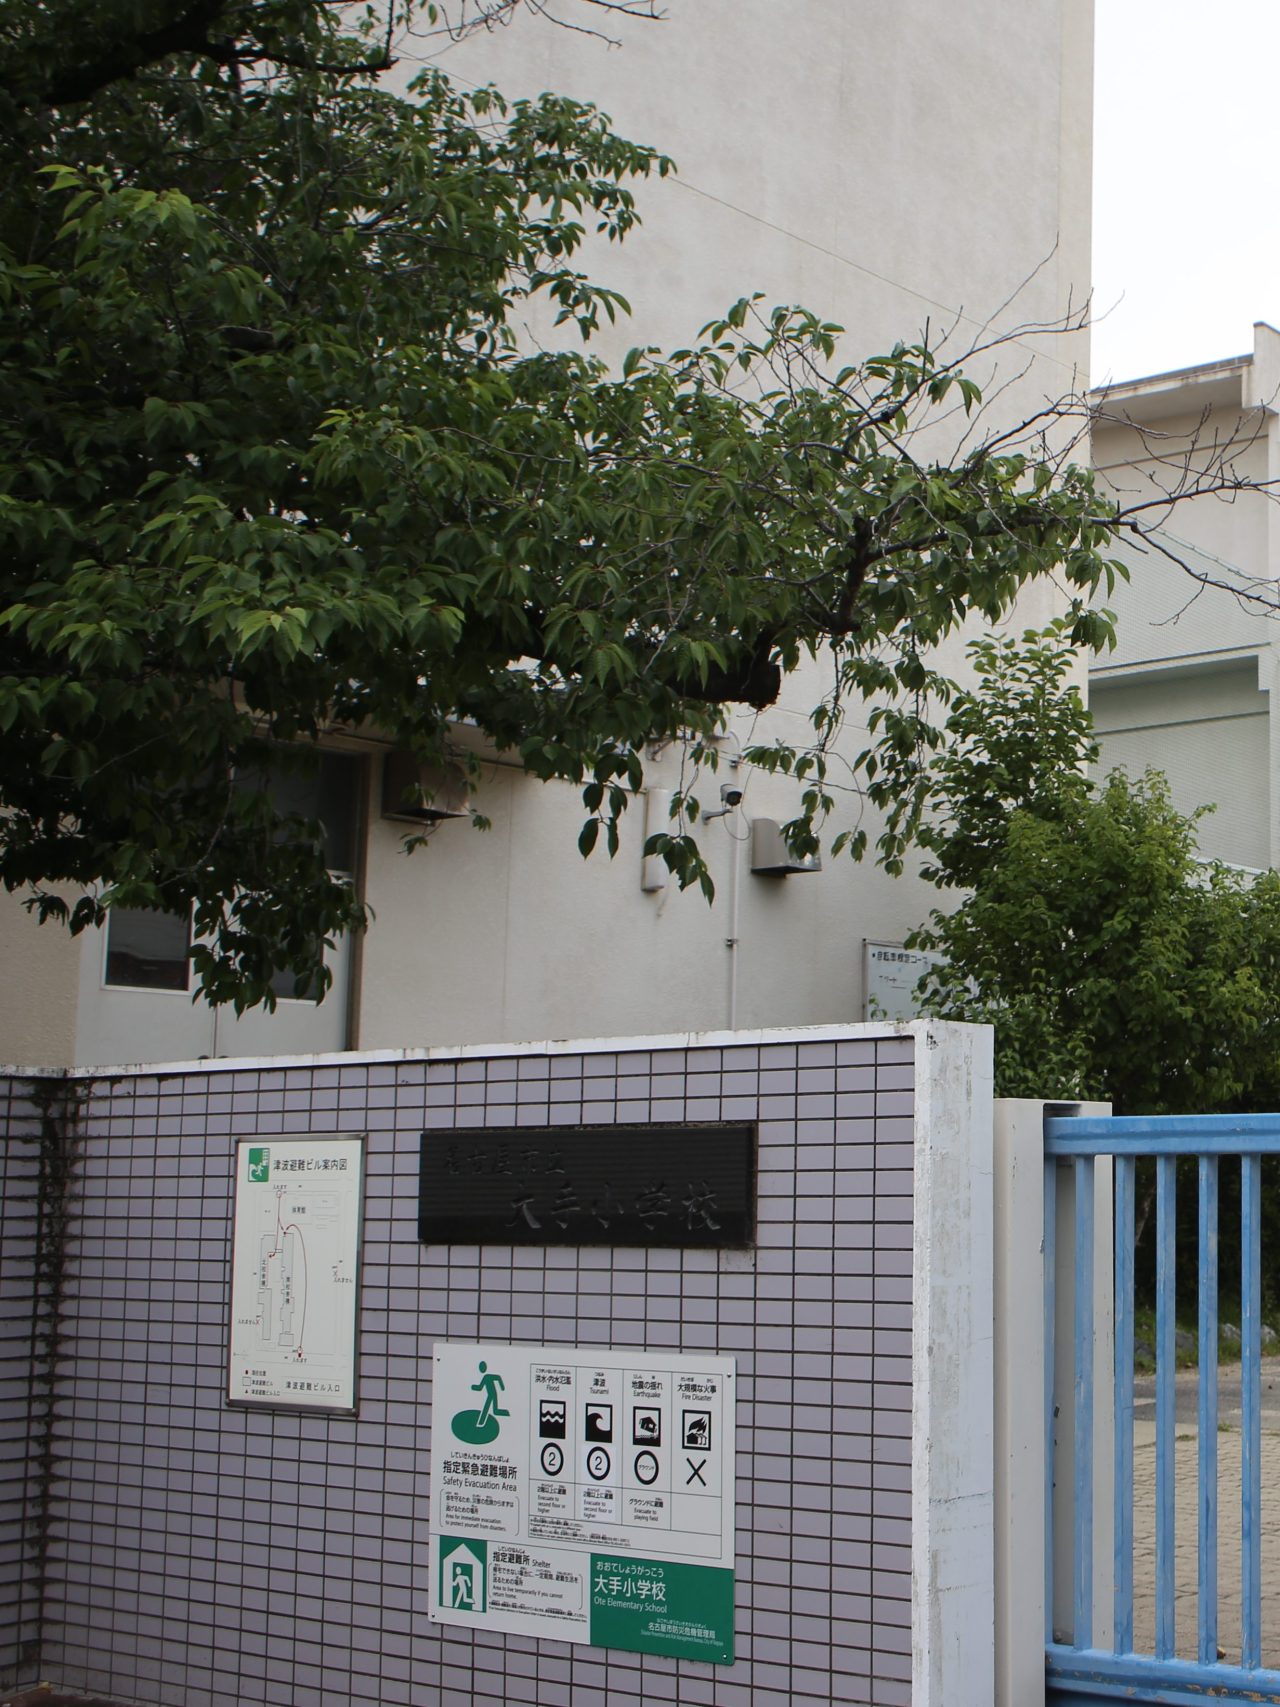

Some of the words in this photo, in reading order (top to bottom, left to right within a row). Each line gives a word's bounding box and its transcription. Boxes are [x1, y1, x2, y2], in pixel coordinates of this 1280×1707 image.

[273, 1158, 347, 1171] 津波避難ビル案内図
[504, 1180, 721, 1230] 大手小学校
[286, 1381, 340, 1392] 津波避難ビル入口
[633, 1390, 661, 1399] Earthquake
[677, 1383, 717, 1394] 大規模な火事
[548, 1452, 556, 1466] 2
[595, 1456, 603, 1470] 2
[443, 1460, 518, 1480] 指定緊急避難場所
[443, 1476, 463, 1488] Safety
[464, 1478, 500, 1490] Evacuation
[502, 1482, 517, 1492] Area
[493, 1551, 530, 1566] 指定避難所
[532, 1559, 551, 1568] Shelter
[596, 1561, 664, 1578] おおてしょうがっこう
[594, 1574, 666, 1601] 大手小学校
[594, 1596, 606, 1605] Ote
[607, 1597, 644, 1612] Elementary
[645, 1602, 667, 1613] School
